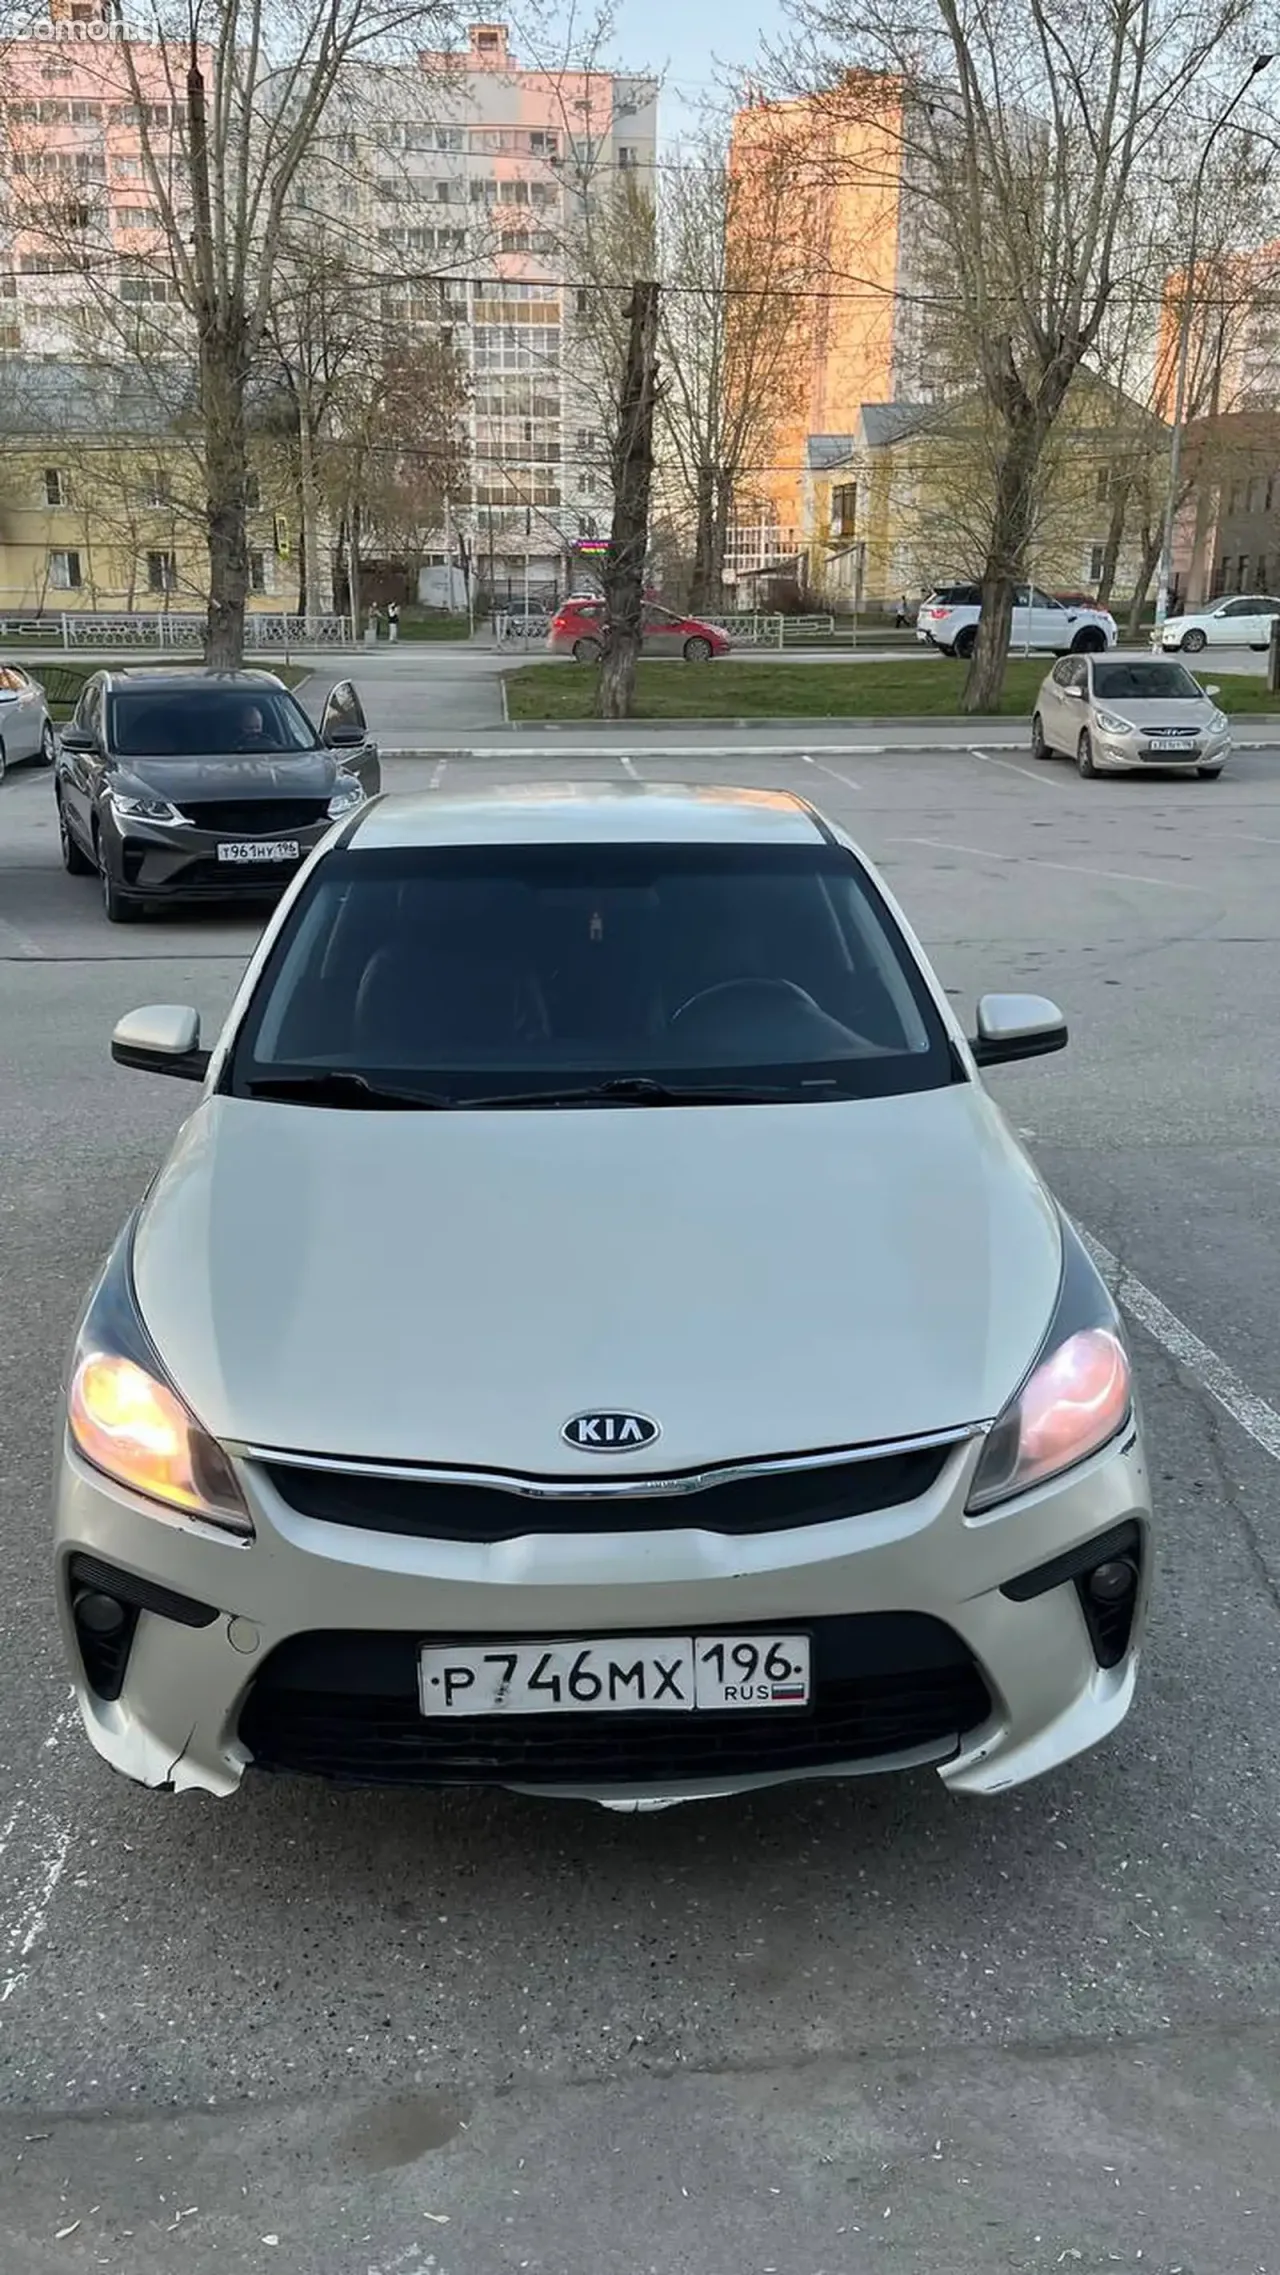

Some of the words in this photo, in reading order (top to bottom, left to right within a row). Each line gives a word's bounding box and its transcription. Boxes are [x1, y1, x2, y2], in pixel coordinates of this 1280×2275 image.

[578, 1418, 644, 1442] KIA
[701, 1642, 792, 1683] 196
[725, 1685, 769, 1701] RUS
